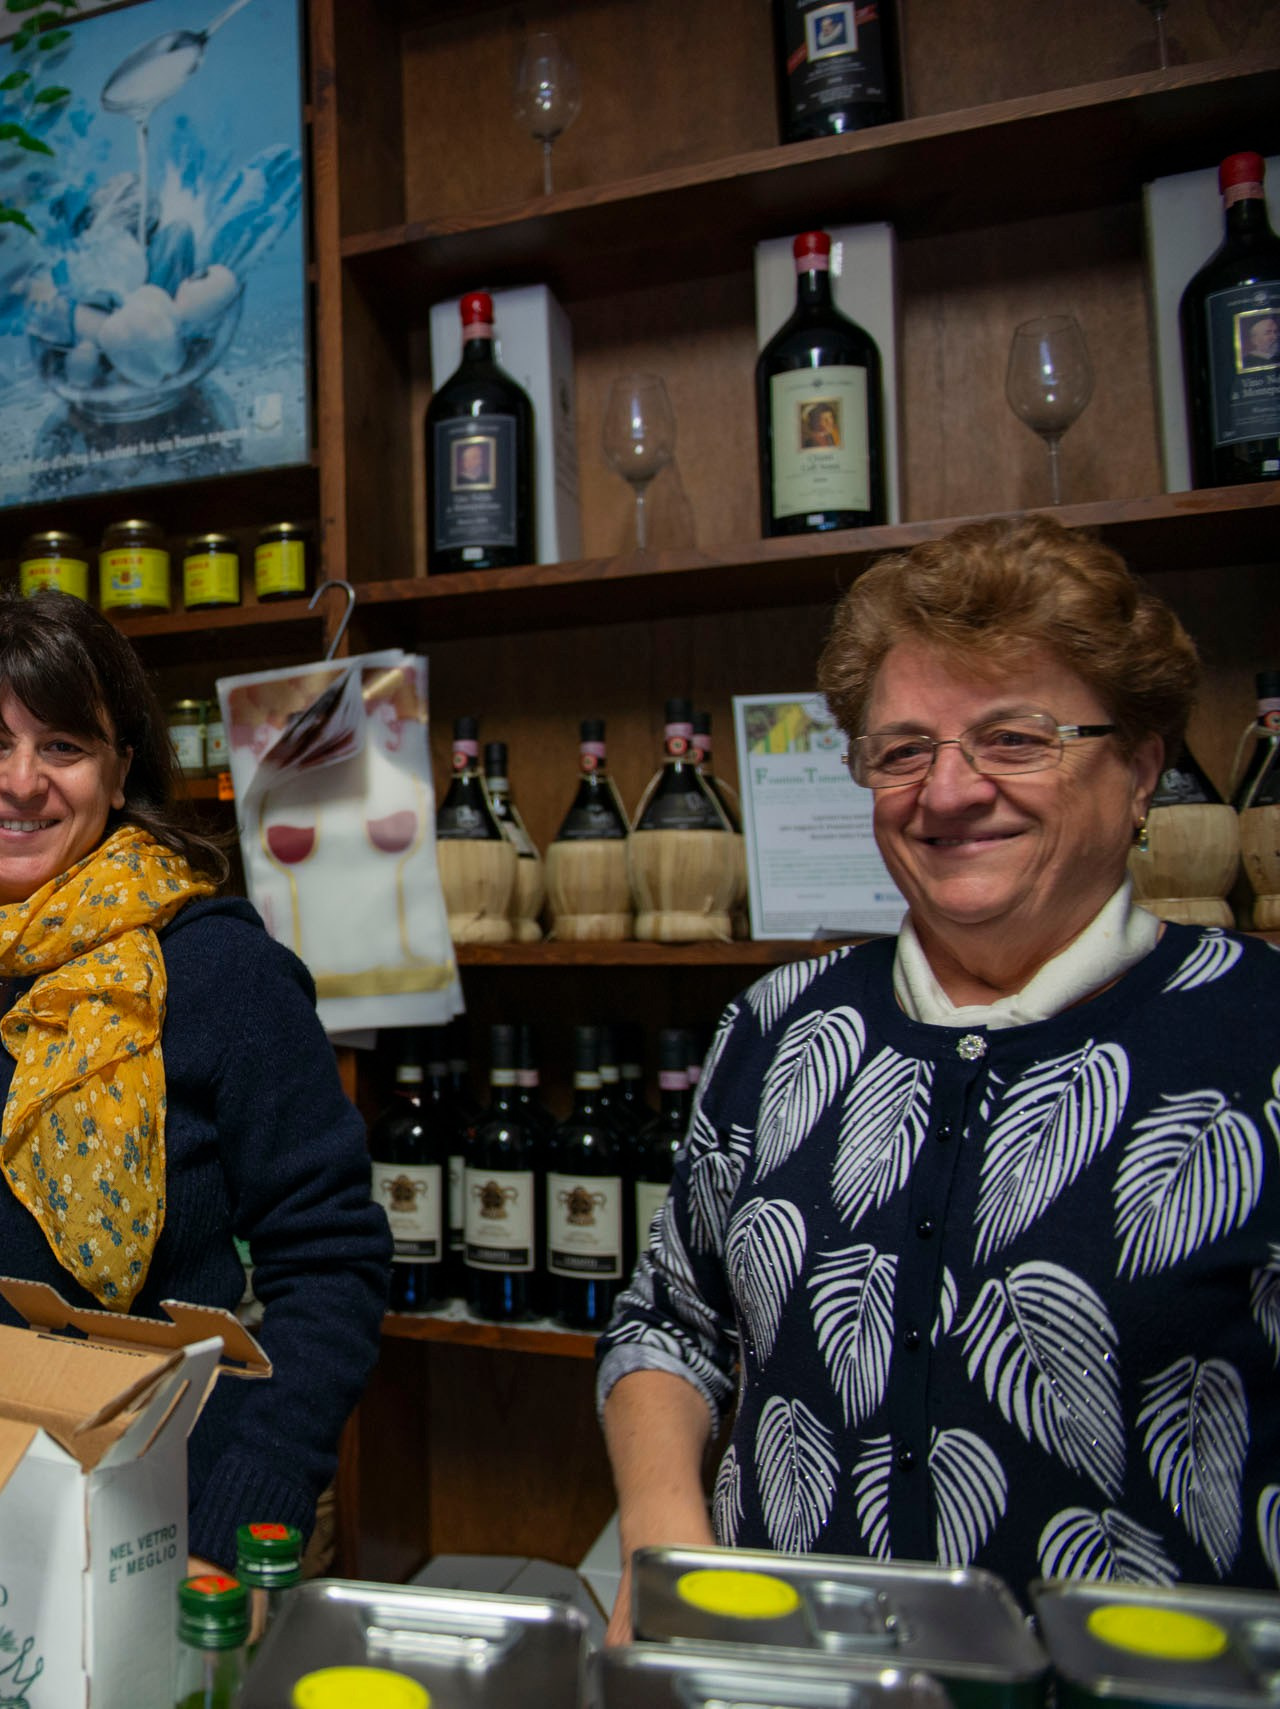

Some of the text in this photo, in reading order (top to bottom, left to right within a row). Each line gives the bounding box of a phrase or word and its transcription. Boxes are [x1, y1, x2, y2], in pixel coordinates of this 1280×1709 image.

[109, 1523, 177, 1563] NEL VETRO
[126, 1544, 177, 1575] MEGLIO
